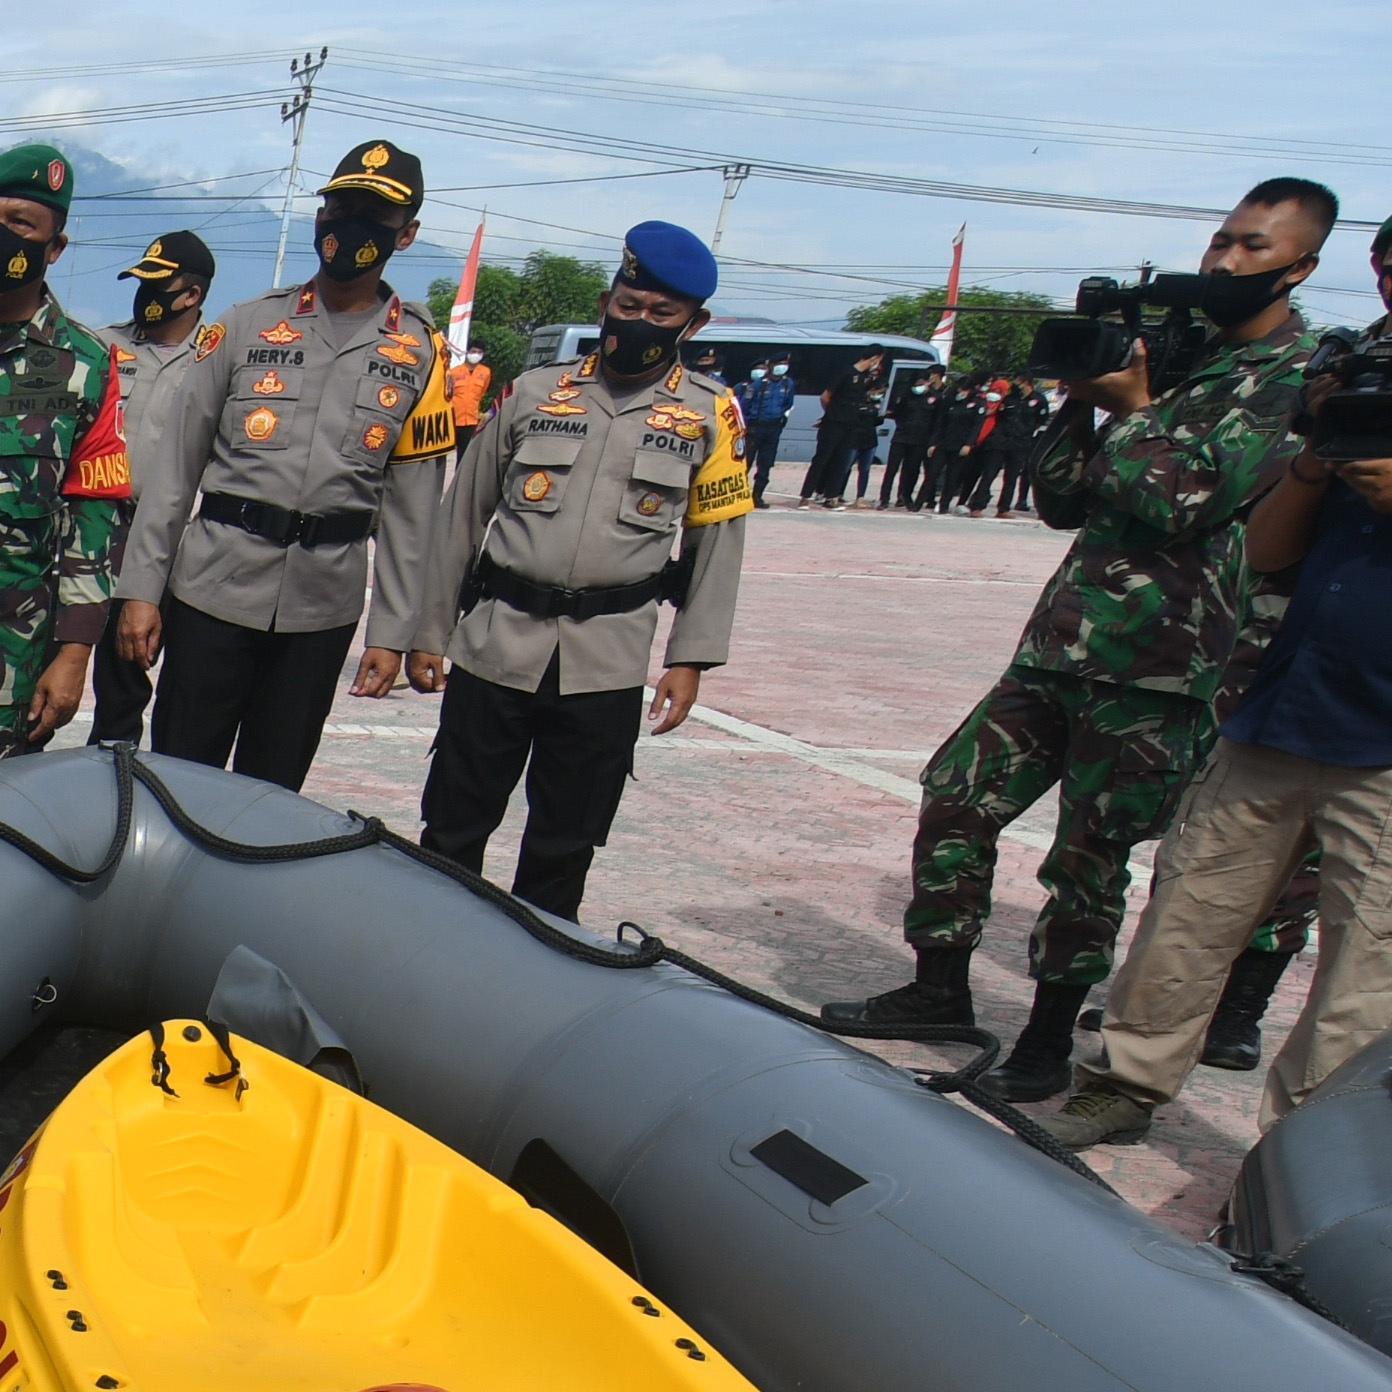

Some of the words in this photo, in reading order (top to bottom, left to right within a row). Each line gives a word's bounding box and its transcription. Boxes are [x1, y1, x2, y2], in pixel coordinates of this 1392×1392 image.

[368, 360, 416, 386] POLRI
[6, 399, 37, 411] TNI
[46, 397, 70, 410] AD
[528, 419, 589, 436] RATHANA
[642, 433, 695, 457] POLRI
[697, 472, 744, 502] KASATGAS
